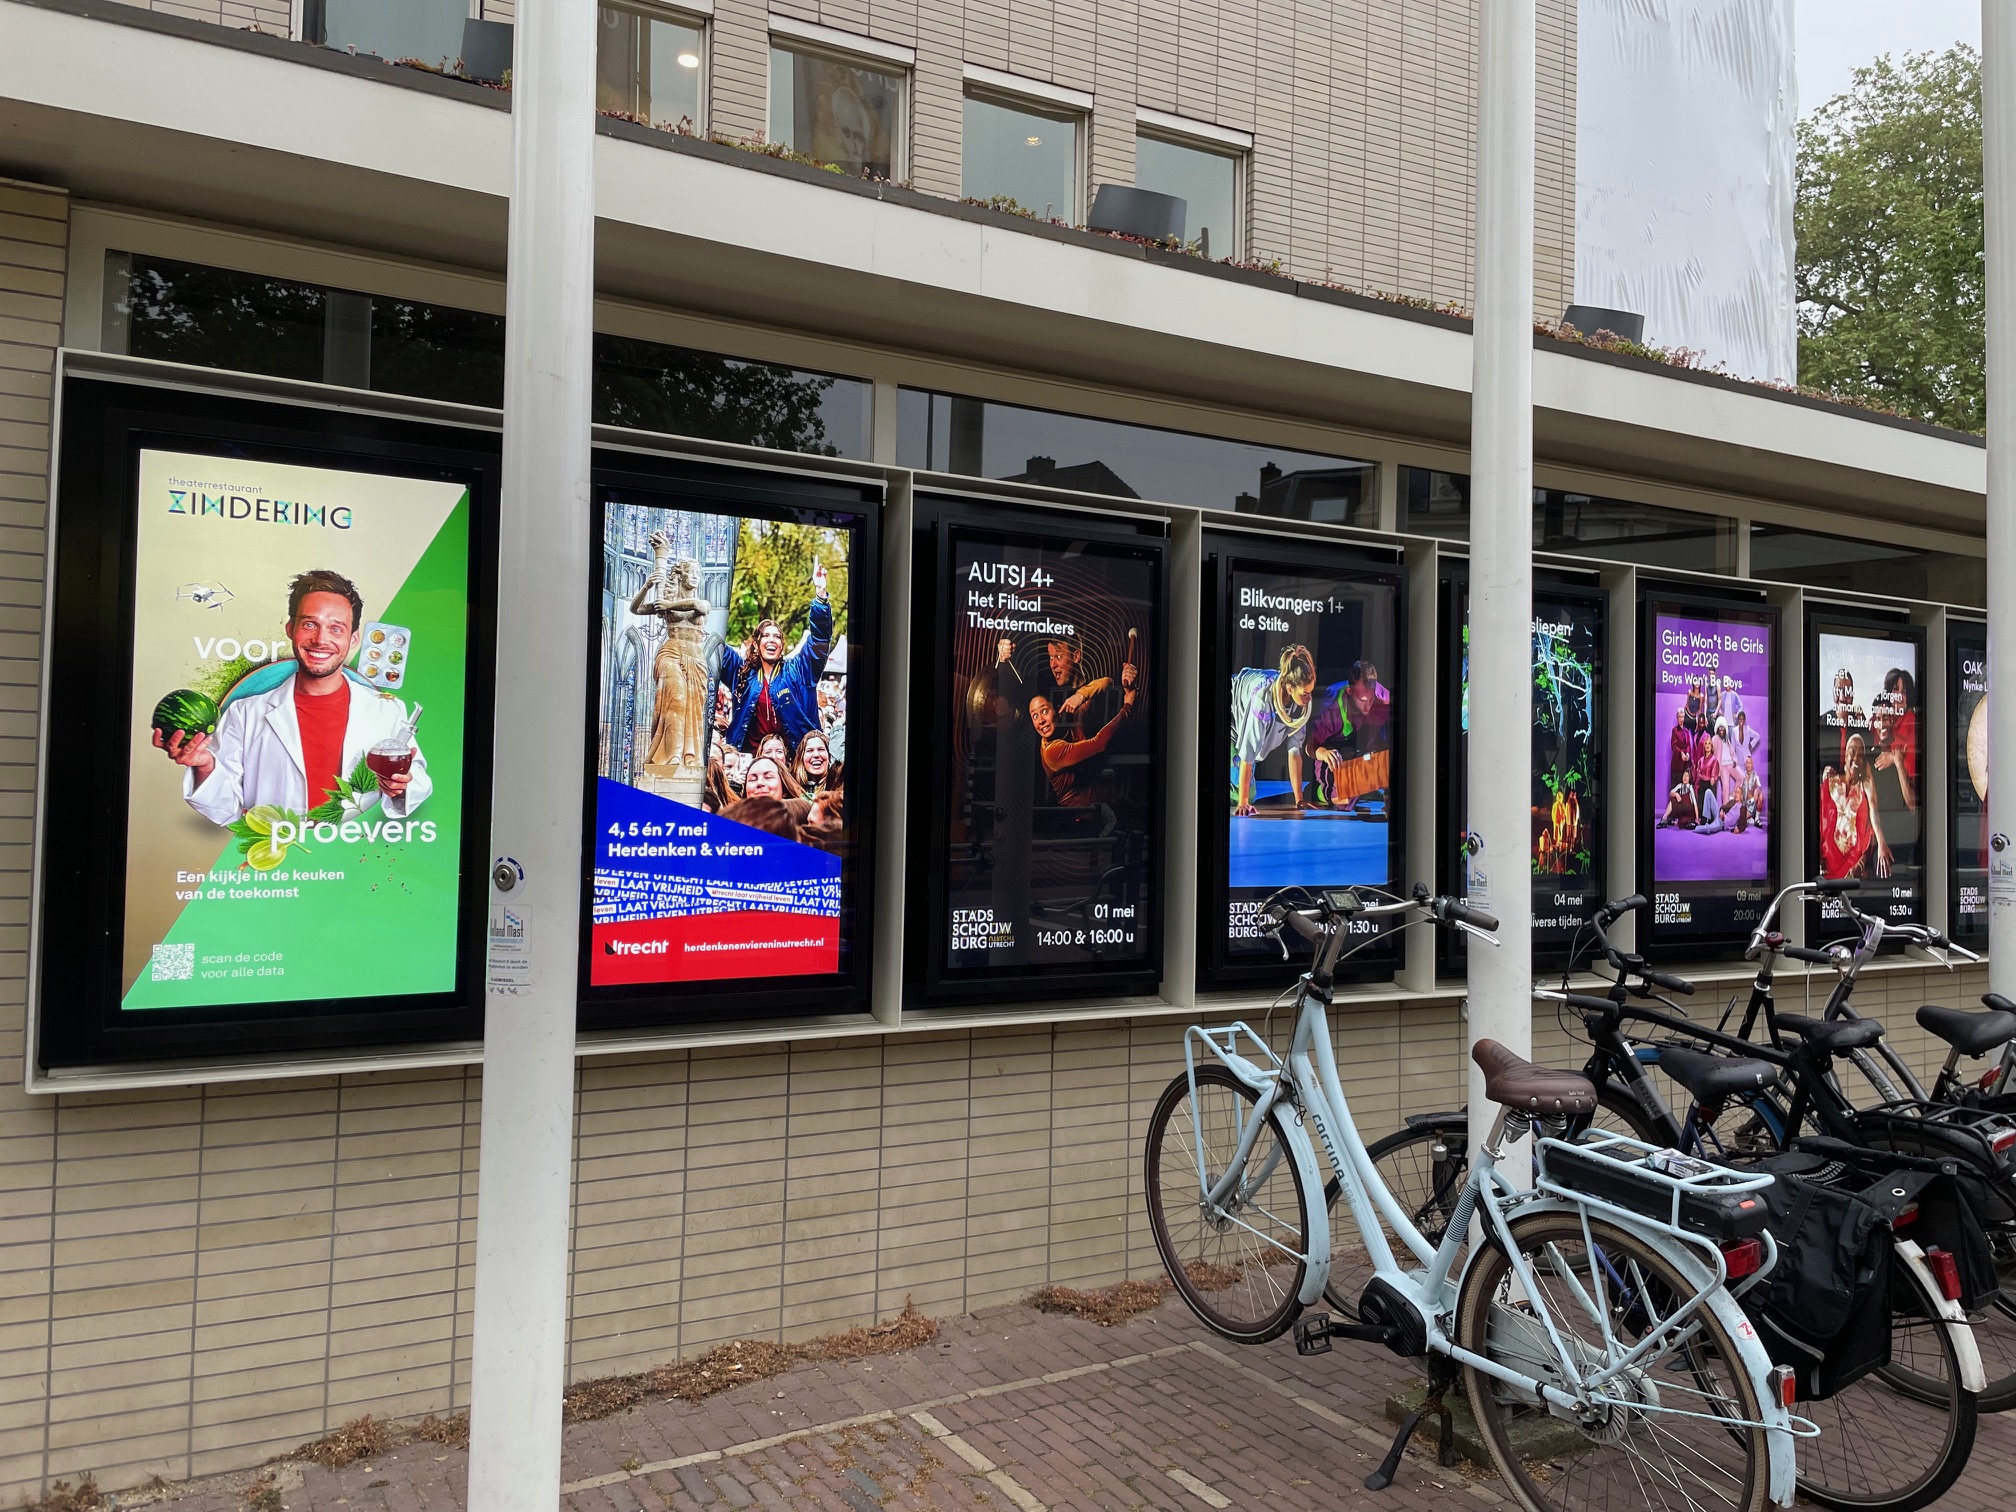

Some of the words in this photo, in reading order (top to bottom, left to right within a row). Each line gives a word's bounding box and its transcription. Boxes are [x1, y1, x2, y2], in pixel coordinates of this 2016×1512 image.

[168, 476, 263, 494] theaterrestaurant
[168, 489, 352, 530] ZINDERING
[968, 561, 1026, 588] AUTSJ
[1030, 567, 1054, 589] 4+
[968, 590, 994, 609] Het
[998, 592, 1041, 612] Filiaal
[1240, 587, 1324, 616] Blikvangers
[1328, 596, 1344, 614] 1+
[967, 611, 1075, 635] Theatermakers
[1239, 615, 1255, 630] de
[1258, 615, 1289, 632] Stilte
[1662, 629, 1688, 647] Girls
[1689, 632, 1722, 650] Won't
[1724, 635, 1738, 652] Be
[1740, 637, 1764, 655] Girls
[193, 636, 287, 663] voor
[1662, 648, 1689, 666] Gala
[1692, 651, 1720, 668] 2026
[1876, 656, 1903, 667] mama
[1963, 660, 1983, 675] OAK
[1662, 670, 1683, 687] Boys
[1684, 672, 1708, 686] Won't
[1710, 674, 1722, 687] Be
[1723, 675, 1743, 691] Boys
[1963, 679, 1984, 693] Nynke
[1895, 704, 1904, 716] La
[1827, 713, 1846, 728] Rose,
[1848, 715, 1873, 731] Ruskey
[270, 816, 437, 853] proevers
[608, 823, 625, 838] 4,
[628, 823, 639, 836] 5
[642, 822, 662, 837] én
[665, 823, 676, 836] 7
[678, 822, 708, 837] mei
[608, 843, 697, 857] Herdenken
[700, 843, 713, 857] &
[715, 843, 763, 857] vieren
[176, 869, 205, 883] Een
[208, 869, 252, 886] kijkje
[253, 869, 268, 882] in
[270, 868, 290, 882] de
[293, 868, 345, 881] keuken
[175, 889, 203, 900] van
[207, 887, 225, 900] de
[228, 886, 299, 899] toekomst
[621, 879, 651, 891] LAAT
[652, 882, 704, 896] VRIJHEID
[749, 892, 773, 902] vrijheid
[774, 895, 791, 903] leven
[794, 895, 821, 907] LAAT
[1655, 893, 1680, 903] STADS
[1737, 890, 1747, 901] 09
[1748, 890, 1762, 901] mei
[1892, 887, 1900, 898] 10
[1901, 887, 1912, 898] mei
[1960, 887, 1978, 896] STADS
[1554, 893, 1566, 906] 04
[1567, 894, 1583, 906] mei
[1960, 896, 1986, 904] SCHOUW
[618, 902, 649, 913] LAAT
[1094, 904, 1109, 919] 01
[1112, 904, 1135, 918] mei
[1655, 903, 1690, 913] SCHOUW
[1822, 909, 1839, 919] BURG
[1889, 905, 1906, 916] 15:30
[1907, 907, 1912, 915] u
[1960, 904, 1975, 913] BURG
[953, 909, 994, 923] STADS
[1559, 914, 1583, 929] tijden
[1655, 913, 1676, 923] BURG
[1734, 910, 1755, 921] 20:00
[1756, 912, 1761, 920] u
[952, 922, 1012, 936] SCHOUW
[1229, 926, 1258, 938] BURG
[1347, 920, 1370, 934] 1:30
[1372, 923, 1379, 933] u
[952, 936, 987, 950] BURG
[988, 941, 1015, 949] UTRECHT
[1036, 930, 1072, 946] 14:00
[1074, 931, 1086, 945] &
[1089, 928, 1124, 944] 16:00
[1125, 931, 1134, 943] u
[684, 938, 824, 953] herdenkenenviereninutrecht.nl
[202, 953, 232, 965] scan
[235, 951, 251, 964] de
[254, 951, 283, 963] code
[201, 967, 228, 979] voor
[230, 965, 253, 978] alle
[256, 964, 285, 977] data
[1636, 1081, 1661, 1116] GAZELLE
